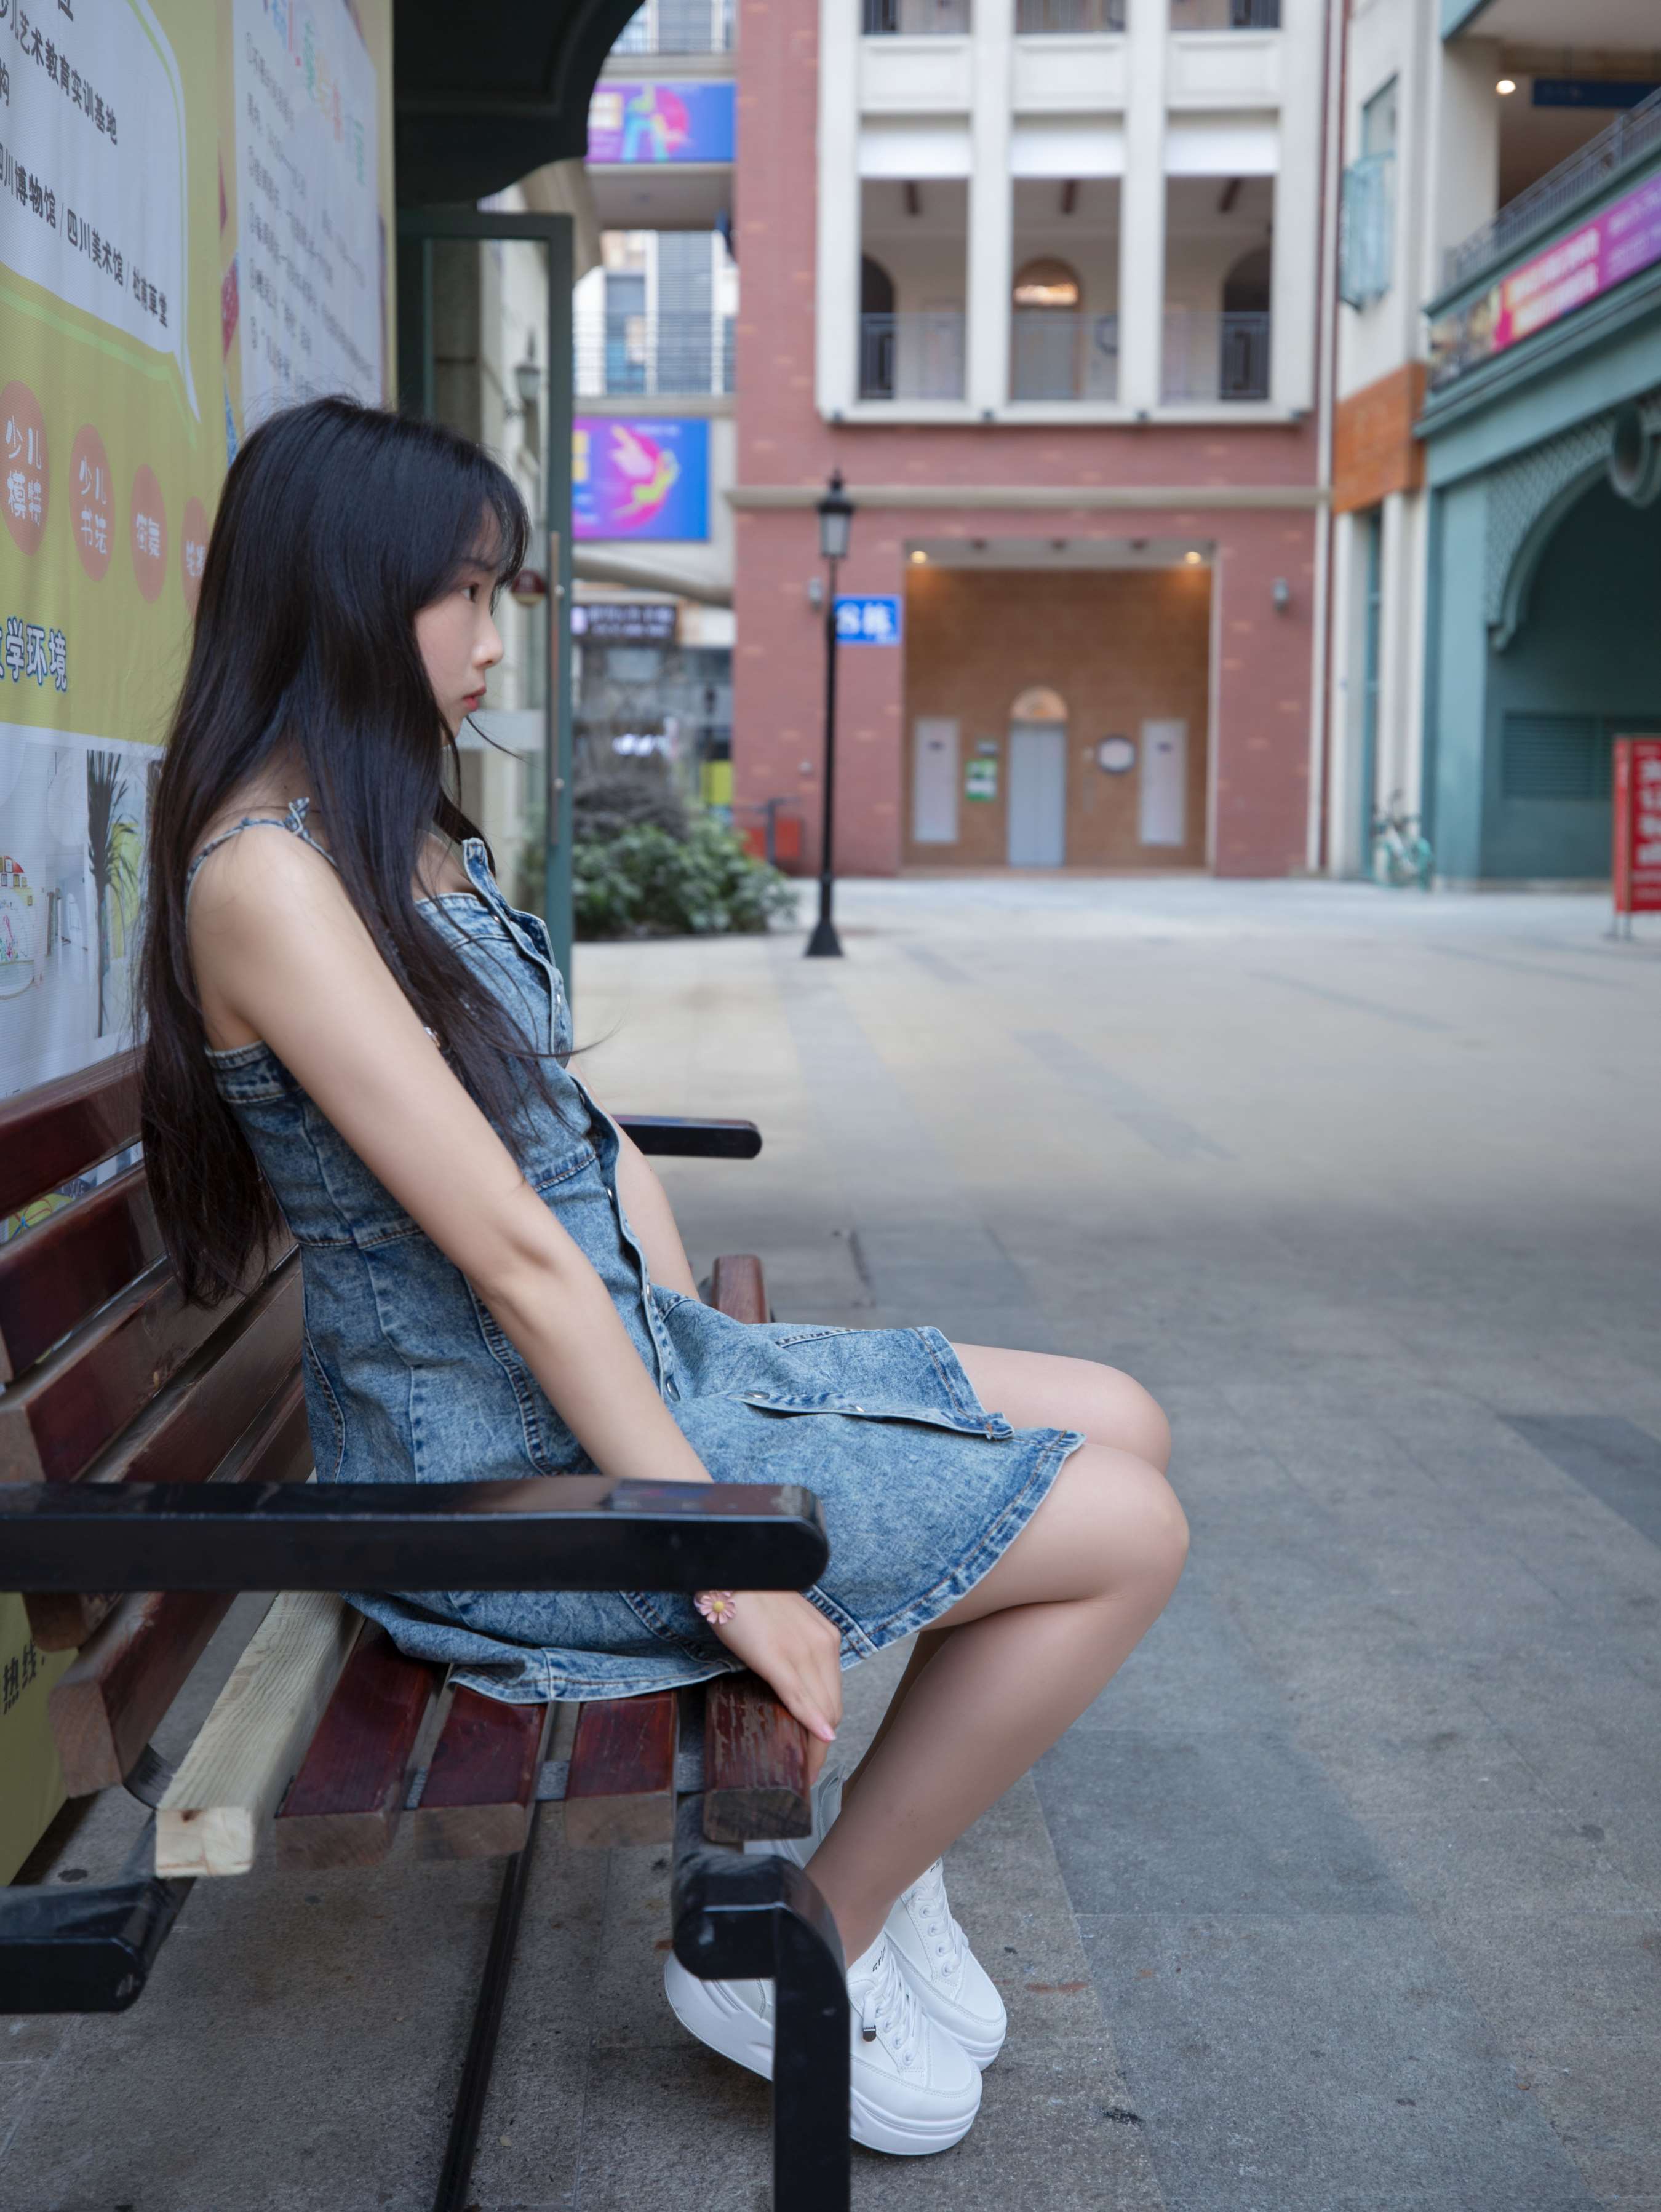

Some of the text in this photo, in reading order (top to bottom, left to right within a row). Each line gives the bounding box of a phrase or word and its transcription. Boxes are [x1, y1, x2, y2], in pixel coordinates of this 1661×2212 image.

[0, 141, 56, 229] 川博物馆
[67, 208, 124, 287] 四川美术馆
[6, 415, 42, 469] 少儿
[79, 455, 106, 504] 少儿
[0, 616, 67, 692] 学环境
